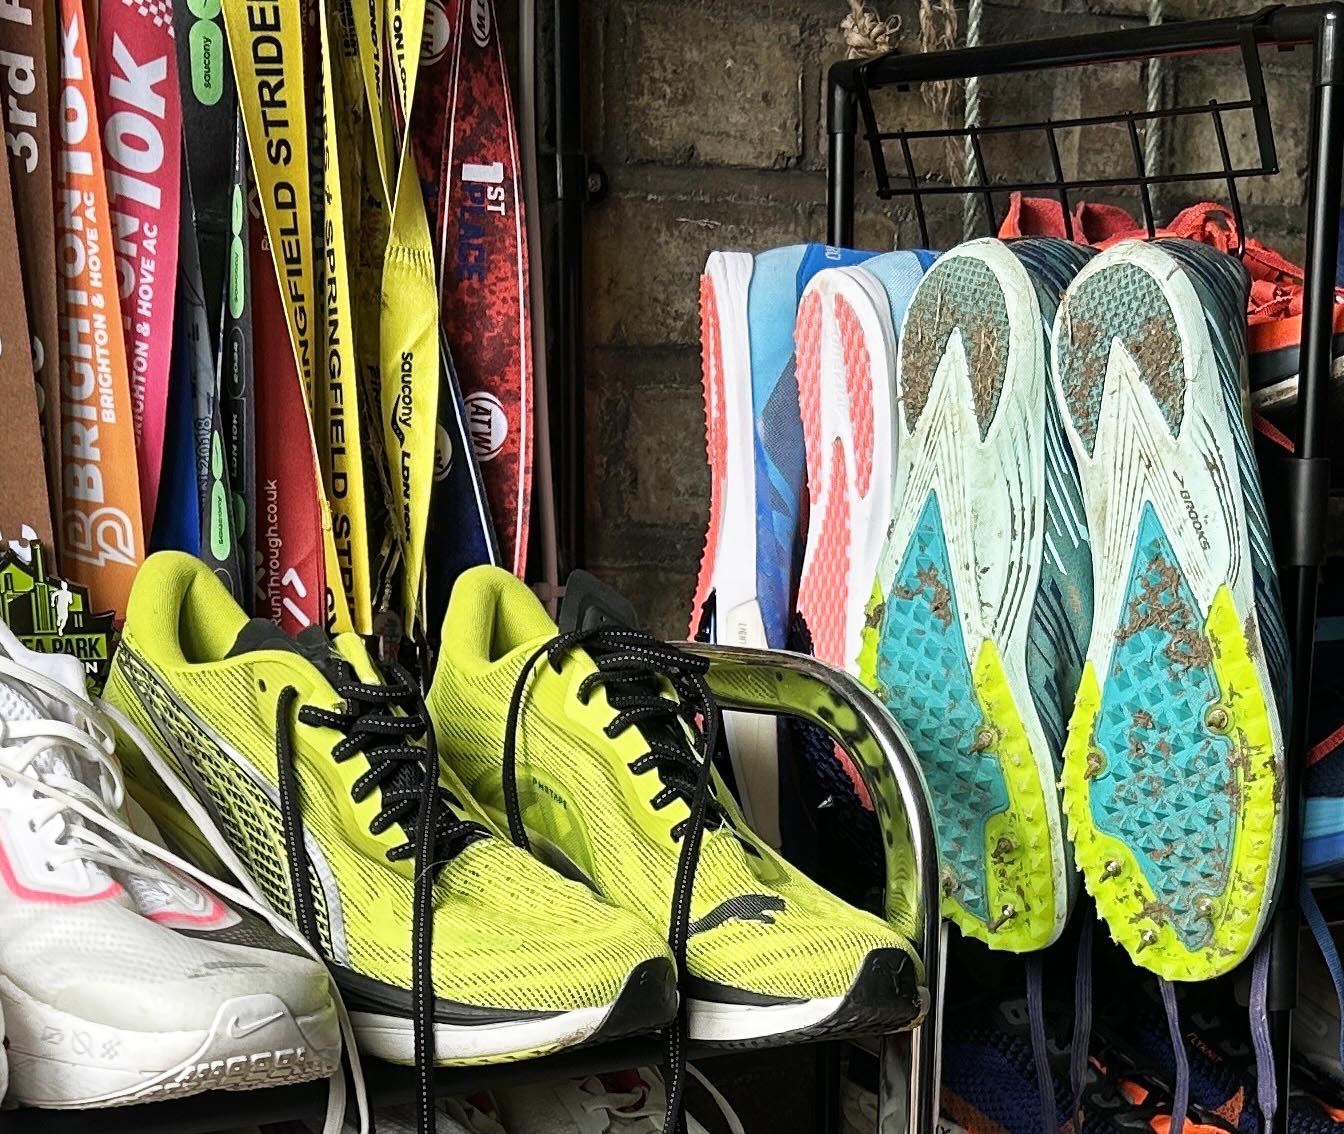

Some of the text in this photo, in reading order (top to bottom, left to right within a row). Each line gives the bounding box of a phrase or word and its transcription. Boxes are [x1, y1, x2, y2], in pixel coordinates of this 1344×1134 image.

[203, 36, 214, 90] saucony
[245, 0, 293, 167] STRIDE
[0, 50, 39, 174] 3rd
[106, 32, 168, 210] 10K
[461, 161, 506, 217] 1ST
[57, 14, 104, 503] BRIGHTON 10K
[142, 222, 158, 256] AC
[457, 183, 487, 283] PLACE
[82, 191, 116, 424] BRIGHTON & HOVE AC
[137, 257, 157, 318] HOVE
[136, 321, 152, 338] &
[324, 219, 349, 499] SPRINGFIELD
[400, 351, 413, 428] saucony
[469, 402, 493, 452] ATW
[401, 450, 411, 499] LDN
[1179, 489, 1211, 553] BROOKS
[51, 637, 102, 659] PARK
